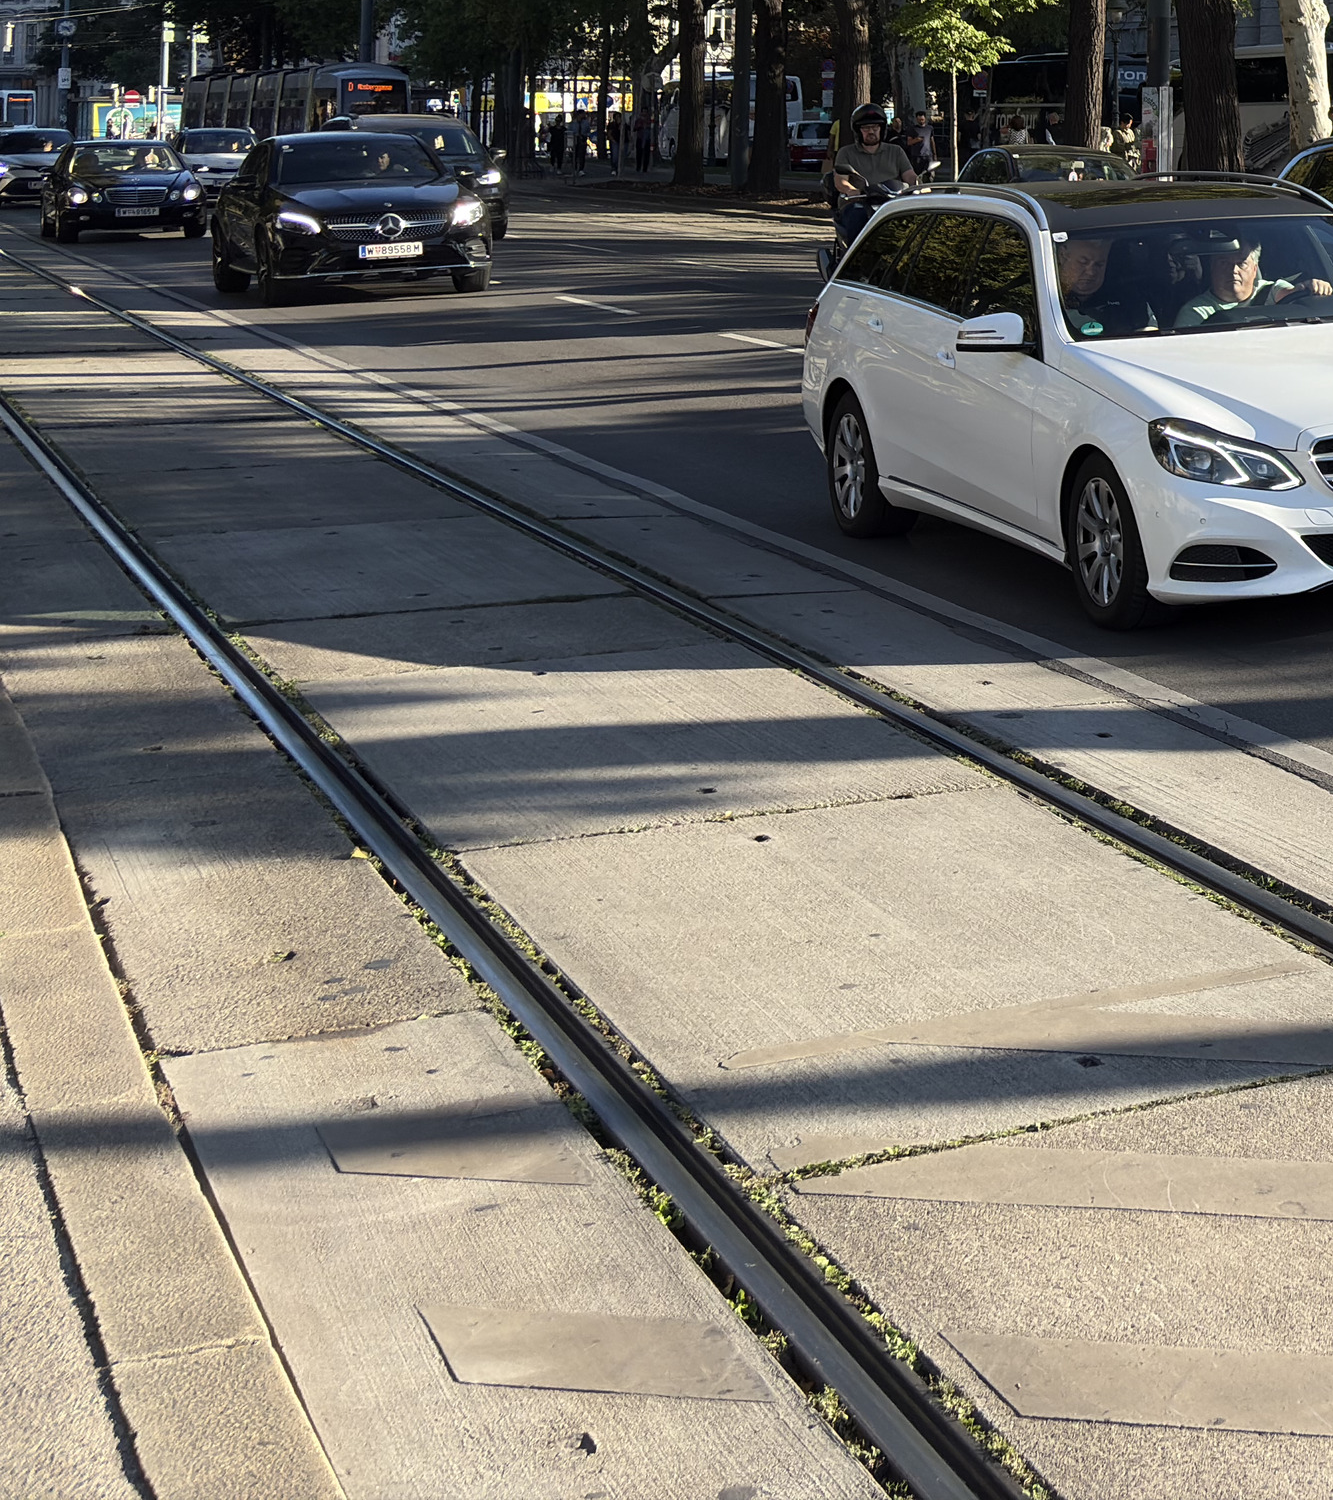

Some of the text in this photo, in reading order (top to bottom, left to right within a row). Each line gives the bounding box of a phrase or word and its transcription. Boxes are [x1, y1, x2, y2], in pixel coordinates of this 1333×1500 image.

[367, 244, 420, 255] W 89558 M
